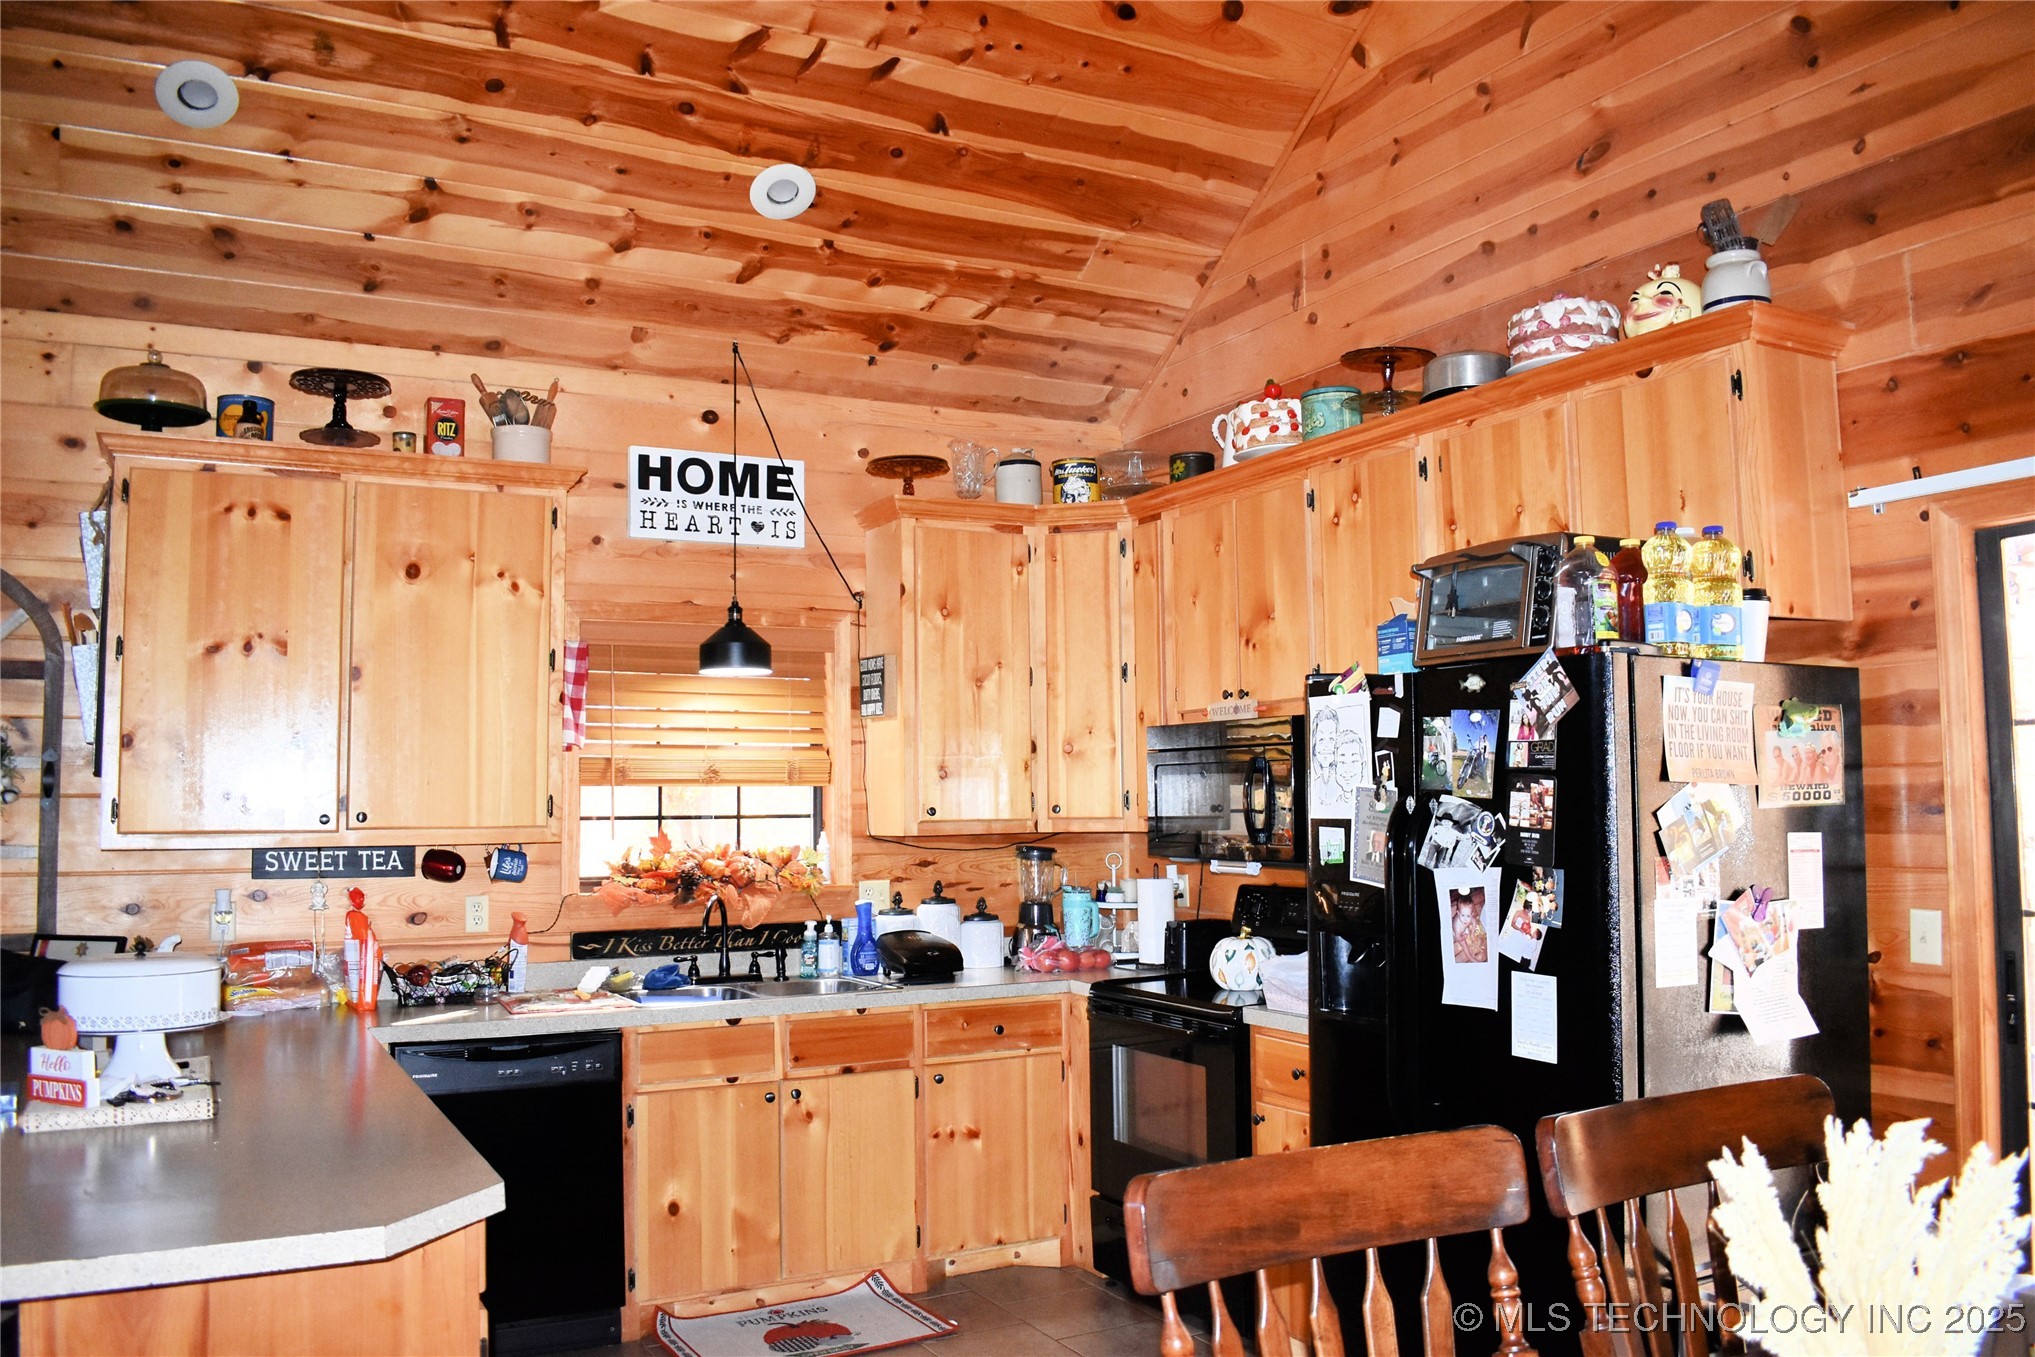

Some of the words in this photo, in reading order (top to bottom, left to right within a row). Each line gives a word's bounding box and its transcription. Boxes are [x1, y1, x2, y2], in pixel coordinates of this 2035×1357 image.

[437, 421, 456, 437] RITZ
[638, 454, 795, 501] HOME
[676, 499, 688, 509] IS
[692, 500, 736, 512] WHERE
[741, 504, 763, 515] THE
[639, 510, 742, 536] HEART
[771, 520, 797, 539] IS
[1674, 686, 1690, 703] IT'S
[1716, 690, 1743, 708] HOUSE
[1545, 698, 1568, 724] RUN
[1668, 704, 1690, 722] NOW.
[1692, 706, 1709, 723] YOU
[1710, 708, 1728, 724] CAN
[1730, 709, 1748, 726] SHIT
[1668, 722, 1677, 739] IN
[1679, 724, 1695, 740] THE
[1696, 724, 1724, 742] LIVING
[1726, 727, 1749, 744] ROOM
[1810, 723, 1836, 732] alive
[1530, 742, 1554, 752] GRAD
[1669, 741, 1696, 758] FLOOR
[1696, 743, 1704, 758] IF
[1706, 744, 1723, 760] YOU
[1724, 745, 1752, 762] WANT.
[1715, 768, 1736, 780] BROWN
[265, 850, 348, 872] SWEET
[358, 850, 404, 871] TEA
[602, 938, 616, 954] I
[616, 936, 653, 957] Kiss
[659, 935, 710, 951] Better
[712, 928, 756, 948] Than
[758, 930, 770, 946] I
[773, 929, 805, 944] Coo
[40, 1053, 71, 1072] Hello
[32, 1079, 82, 1102] PUMPKINS
[736, 1306, 828, 1328] PUMPKINS
